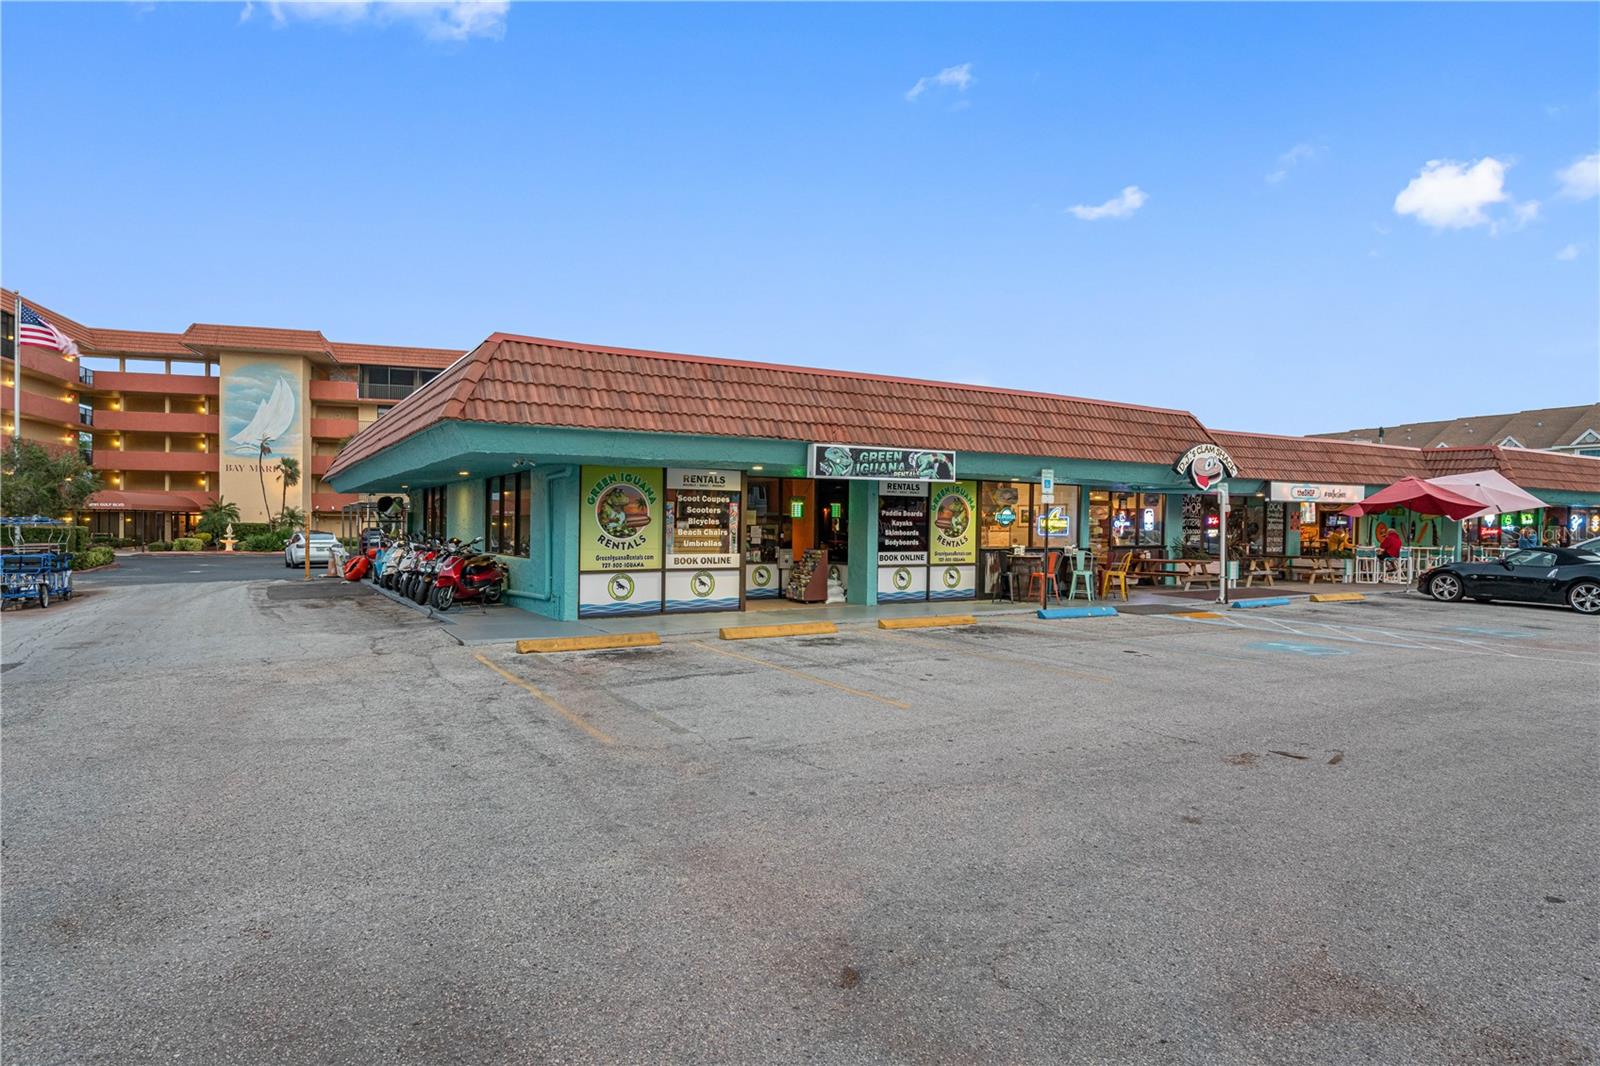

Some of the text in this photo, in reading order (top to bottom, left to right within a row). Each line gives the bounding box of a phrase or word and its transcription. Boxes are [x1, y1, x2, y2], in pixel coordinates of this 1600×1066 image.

[859, 451, 903, 462] GREEN
[1196, 445, 1215, 455] CLAM
[1215, 448, 1236, 475] SHACK
[225, 464, 245, 473] BAY
[856, 462, 906, 473] IGUANA
[683, 474, 726, 484] RENTALS
[587, 473, 656, 505] GREEN IGUANA
[887, 482, 921, 491] RENTALS
[677, 494, 730, 504] Scoot Coupes
[931, 485, 976, 511] GREEN IGUANA
[686, 506, 721, 514] Scooters
[687, 517, 720, 526] Bicycles
[891, 520, 913, 528] Kayaks
[677, 528, 728, 536] Beach Chairs
[884, 529, 919, 537] Skimboards
[597, 534, 647, 551] RENTALS
[683, 539, 722, 547] Umbrellas
[884, 539, 919, 547] Bodyboards
[936, 534, 969, 548] RENTALS
[673, 556, 732, 565] BOOK ONLINE
[879, 554, 925, 562] BOOK ONLINE
